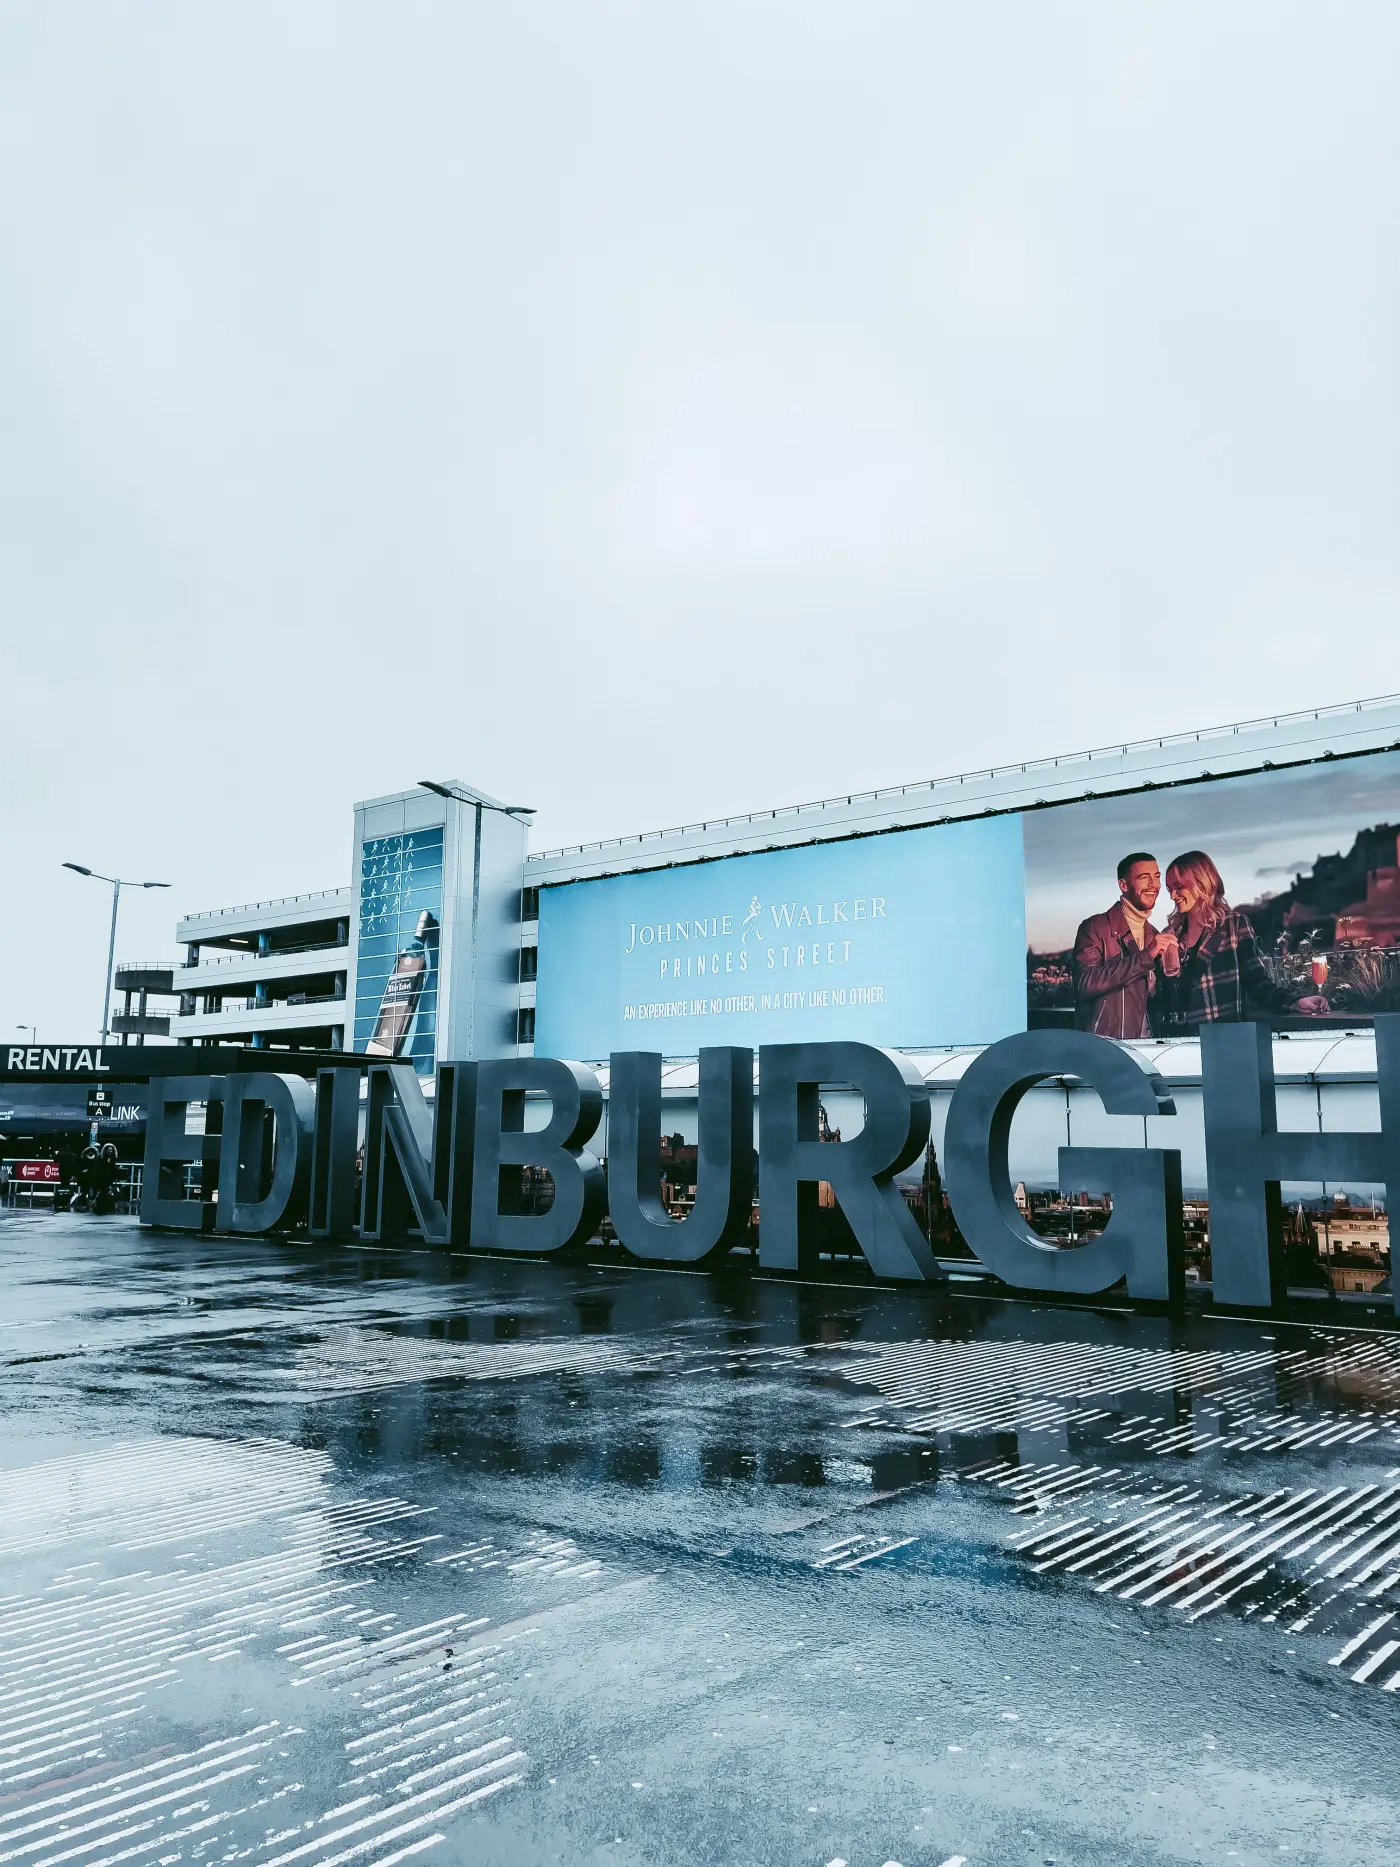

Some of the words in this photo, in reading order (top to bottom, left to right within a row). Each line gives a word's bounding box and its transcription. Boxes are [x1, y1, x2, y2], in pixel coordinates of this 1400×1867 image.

[660, 950, 749, 980] PRINCES
[766, 940, 852, 969] STREET
[623, 1005, 636, 1021] AN
[638, 1000, 688, 1020] EXPERIENCE
[689, 999, 708, 1016] LIKE
[709, 997, 723, 1014] NO
[724, 995, 758, 1013] OTHER,
[761, 994, 772, 1010] IN
[773, 993, 781, 1009] A
[783, 991, 806, 1009] CITY
[808, 990, 829, 1007] LIKE
[831, 989, 847, 1006] NO
[849, 986, 888, 1005] OTHER.
[7, 1048, 110, 1071] RENTAL
[94, 1107, 103, 1116] A
[139, 1013, 1400, 1309] EDINBURGH
